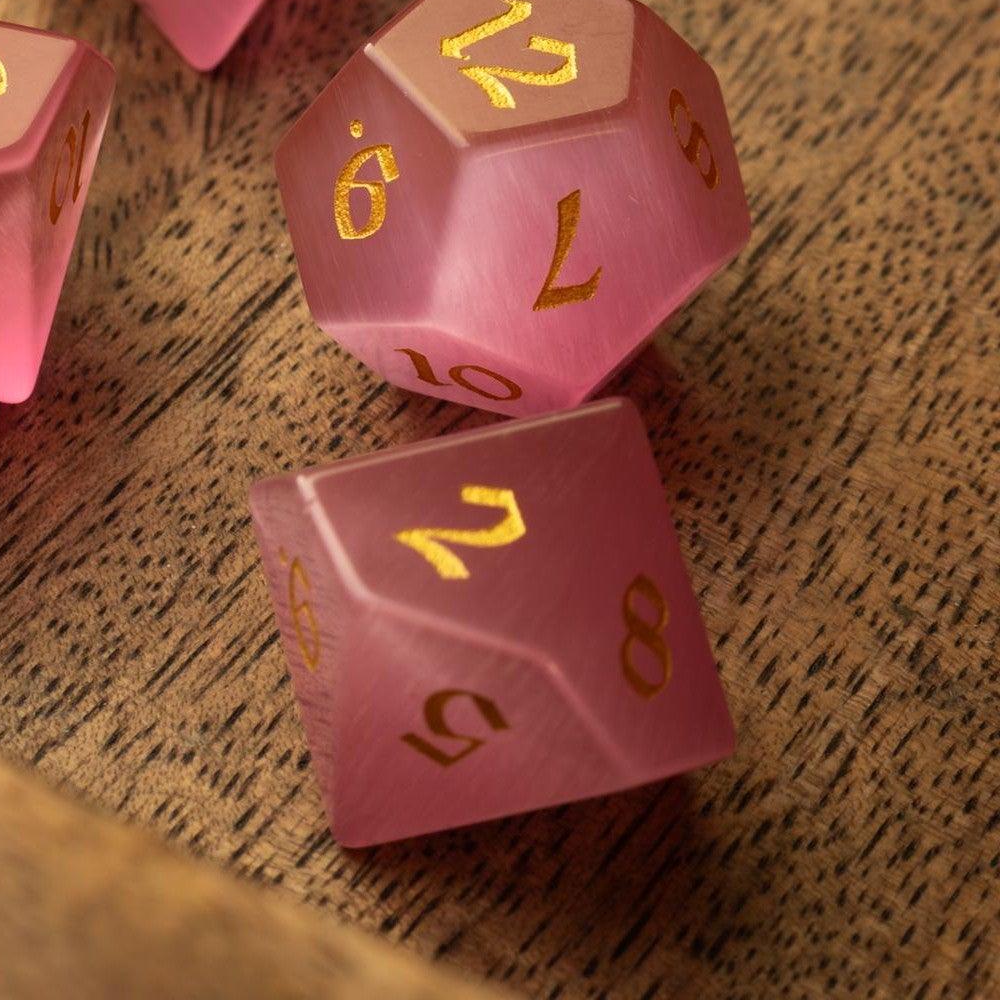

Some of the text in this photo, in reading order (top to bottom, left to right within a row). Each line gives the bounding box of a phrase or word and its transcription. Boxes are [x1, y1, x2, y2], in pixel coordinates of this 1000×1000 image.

[532, 188, 603, 312] 7
[394, 347, 523, 402] 10
[393, 484, 527, 580] 2
[621, 572, 673, 700] 8
[401, 687, 512, 769] 5
